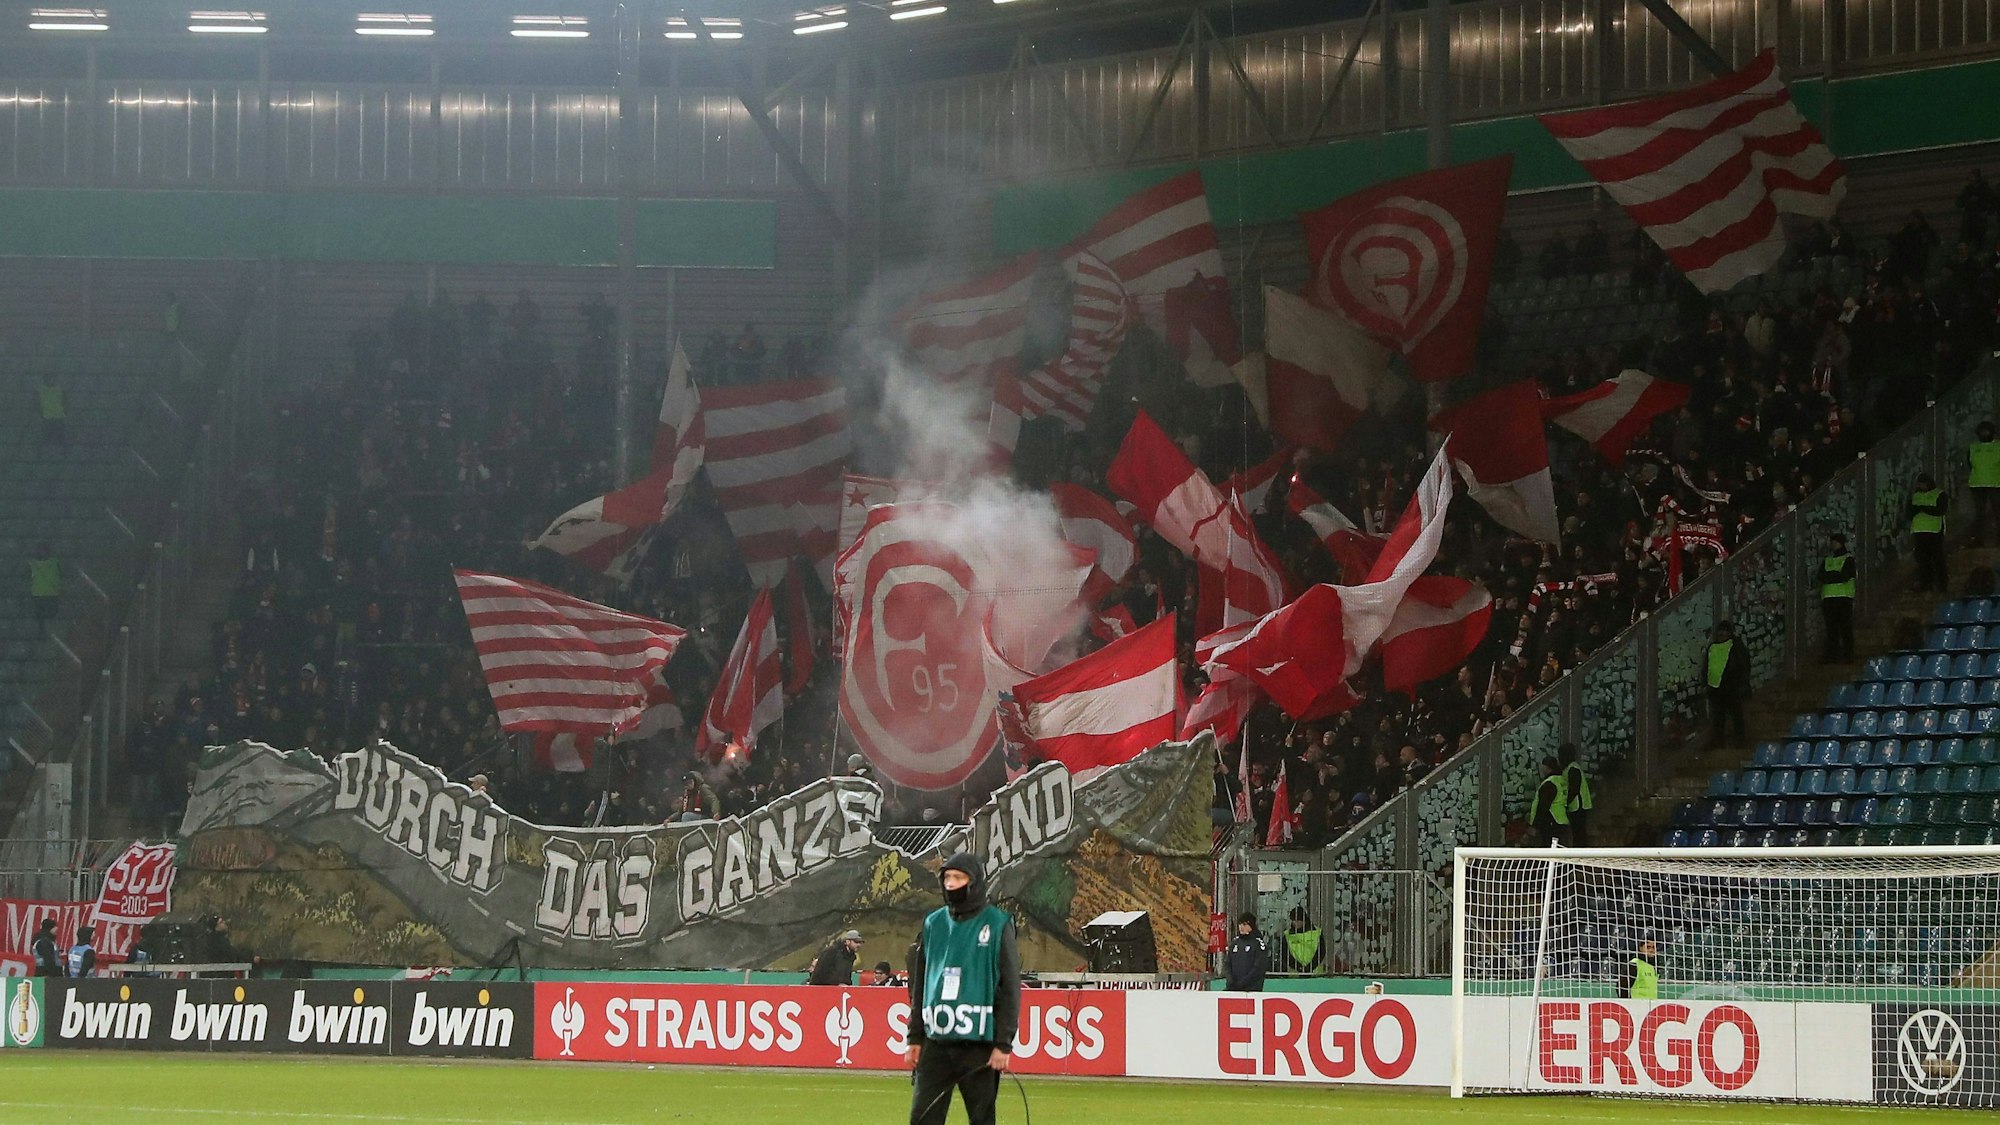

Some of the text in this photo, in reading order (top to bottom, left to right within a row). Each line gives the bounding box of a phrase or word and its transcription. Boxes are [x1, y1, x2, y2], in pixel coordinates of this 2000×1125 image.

[912, 664, 959, 713] 95
[334, 746, 1072, 938] DURCH DAS GANZE AND
[120, 895, 148, 915] 2003
[60, 985, 152, 1040] bwin
[170, 986, 267, 1042] bwin
[287, 987, 388, 1045] bwin
[408, 988, 515, 1047] bwin
[604, 997, 802, 1053] STRAUSS
[886, 1003, 1105, 1060] SUSS
[1217, 997, 1417, 1080] ERGO
[1538, 1002, 1760, 1091] ERGO
